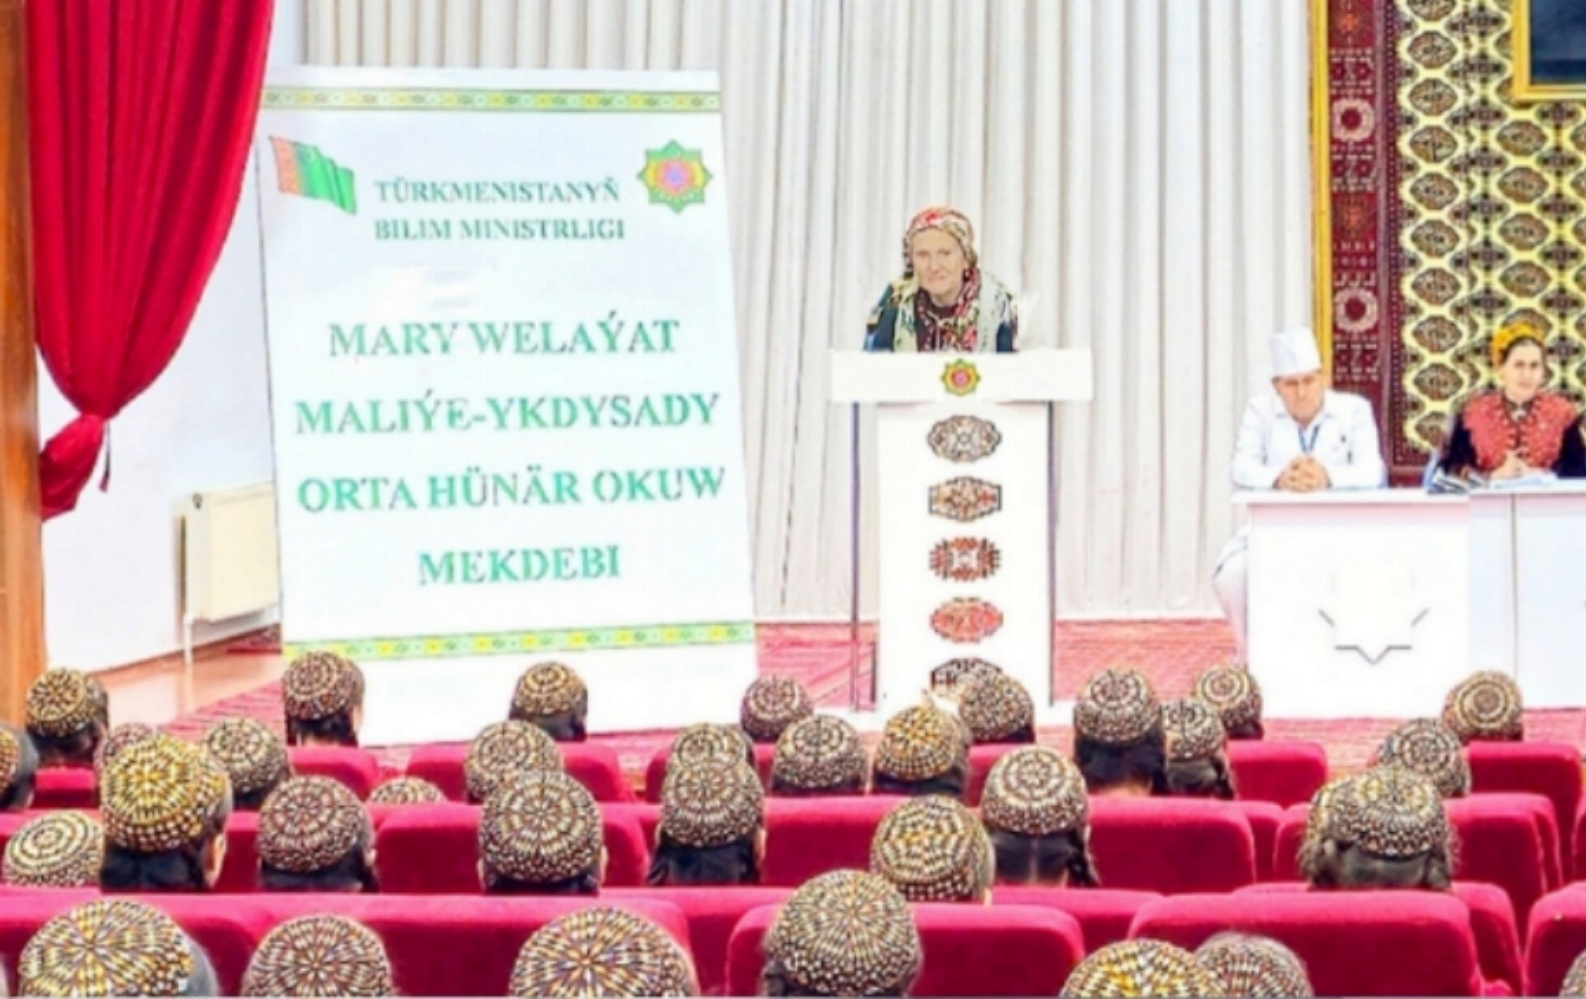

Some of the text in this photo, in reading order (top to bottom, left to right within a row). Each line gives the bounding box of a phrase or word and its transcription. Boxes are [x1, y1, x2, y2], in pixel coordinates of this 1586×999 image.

[374, 176, 621, 204] TÜRKMENISTANYŇ
[374, 218, 625, 241] BILIM MINISTRLIGI
[328, 310, 680, 358] MARY WELAÝAT
[295, 389, 720, 435] MALIÝE-YKDYSADY
[297, 465, 725, 514] ORTA HÜNÄR OKUW
[418, 545, 621, 586] MEKDEBI
